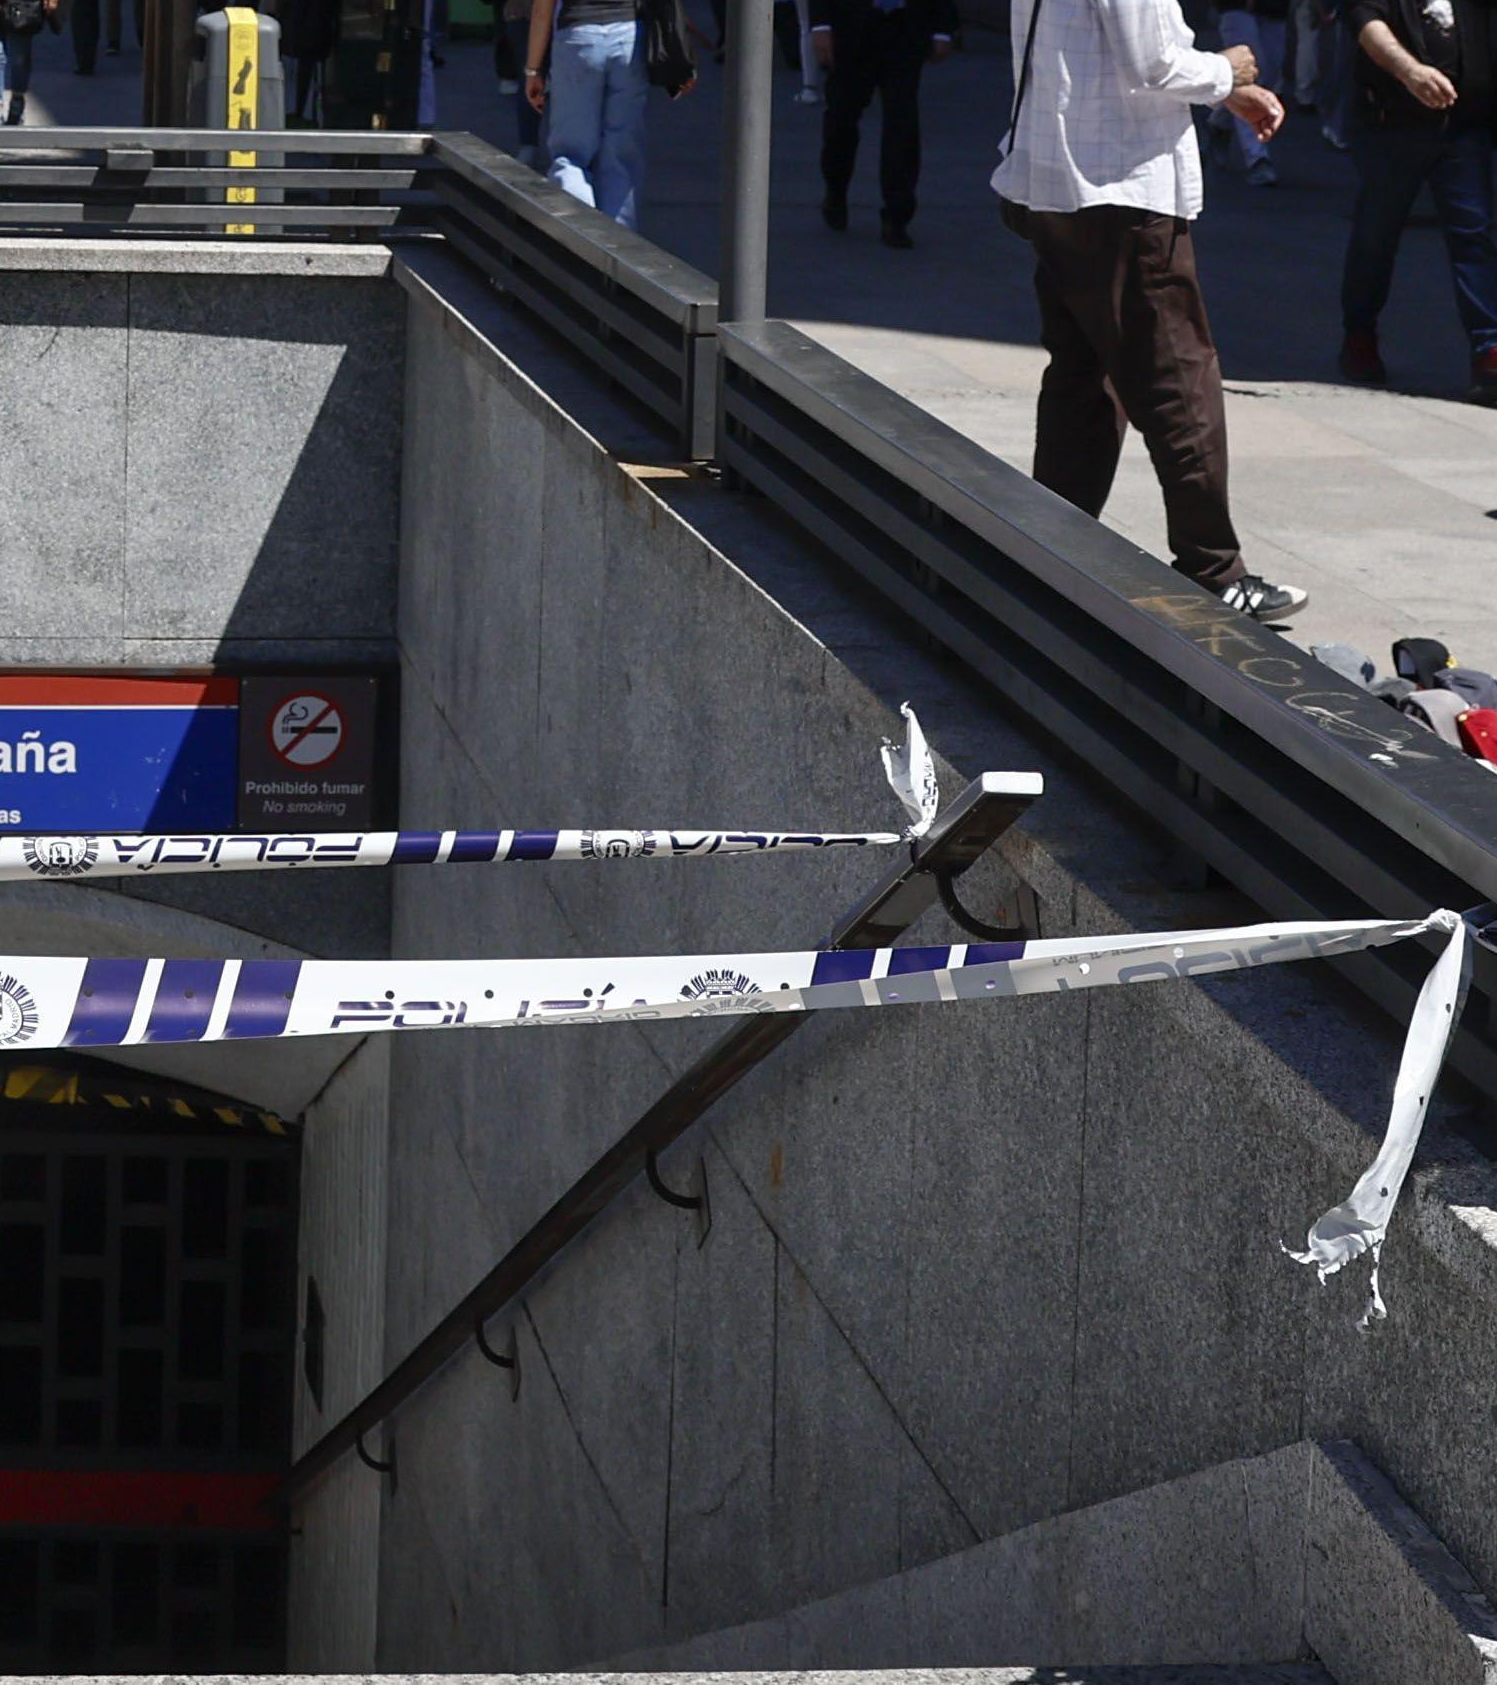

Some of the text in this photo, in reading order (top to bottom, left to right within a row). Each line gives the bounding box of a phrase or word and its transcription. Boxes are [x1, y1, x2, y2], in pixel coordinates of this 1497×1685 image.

[245, 781, 365, 795] Prohibido fumar
[262, 800, 347, 817] No smoking
